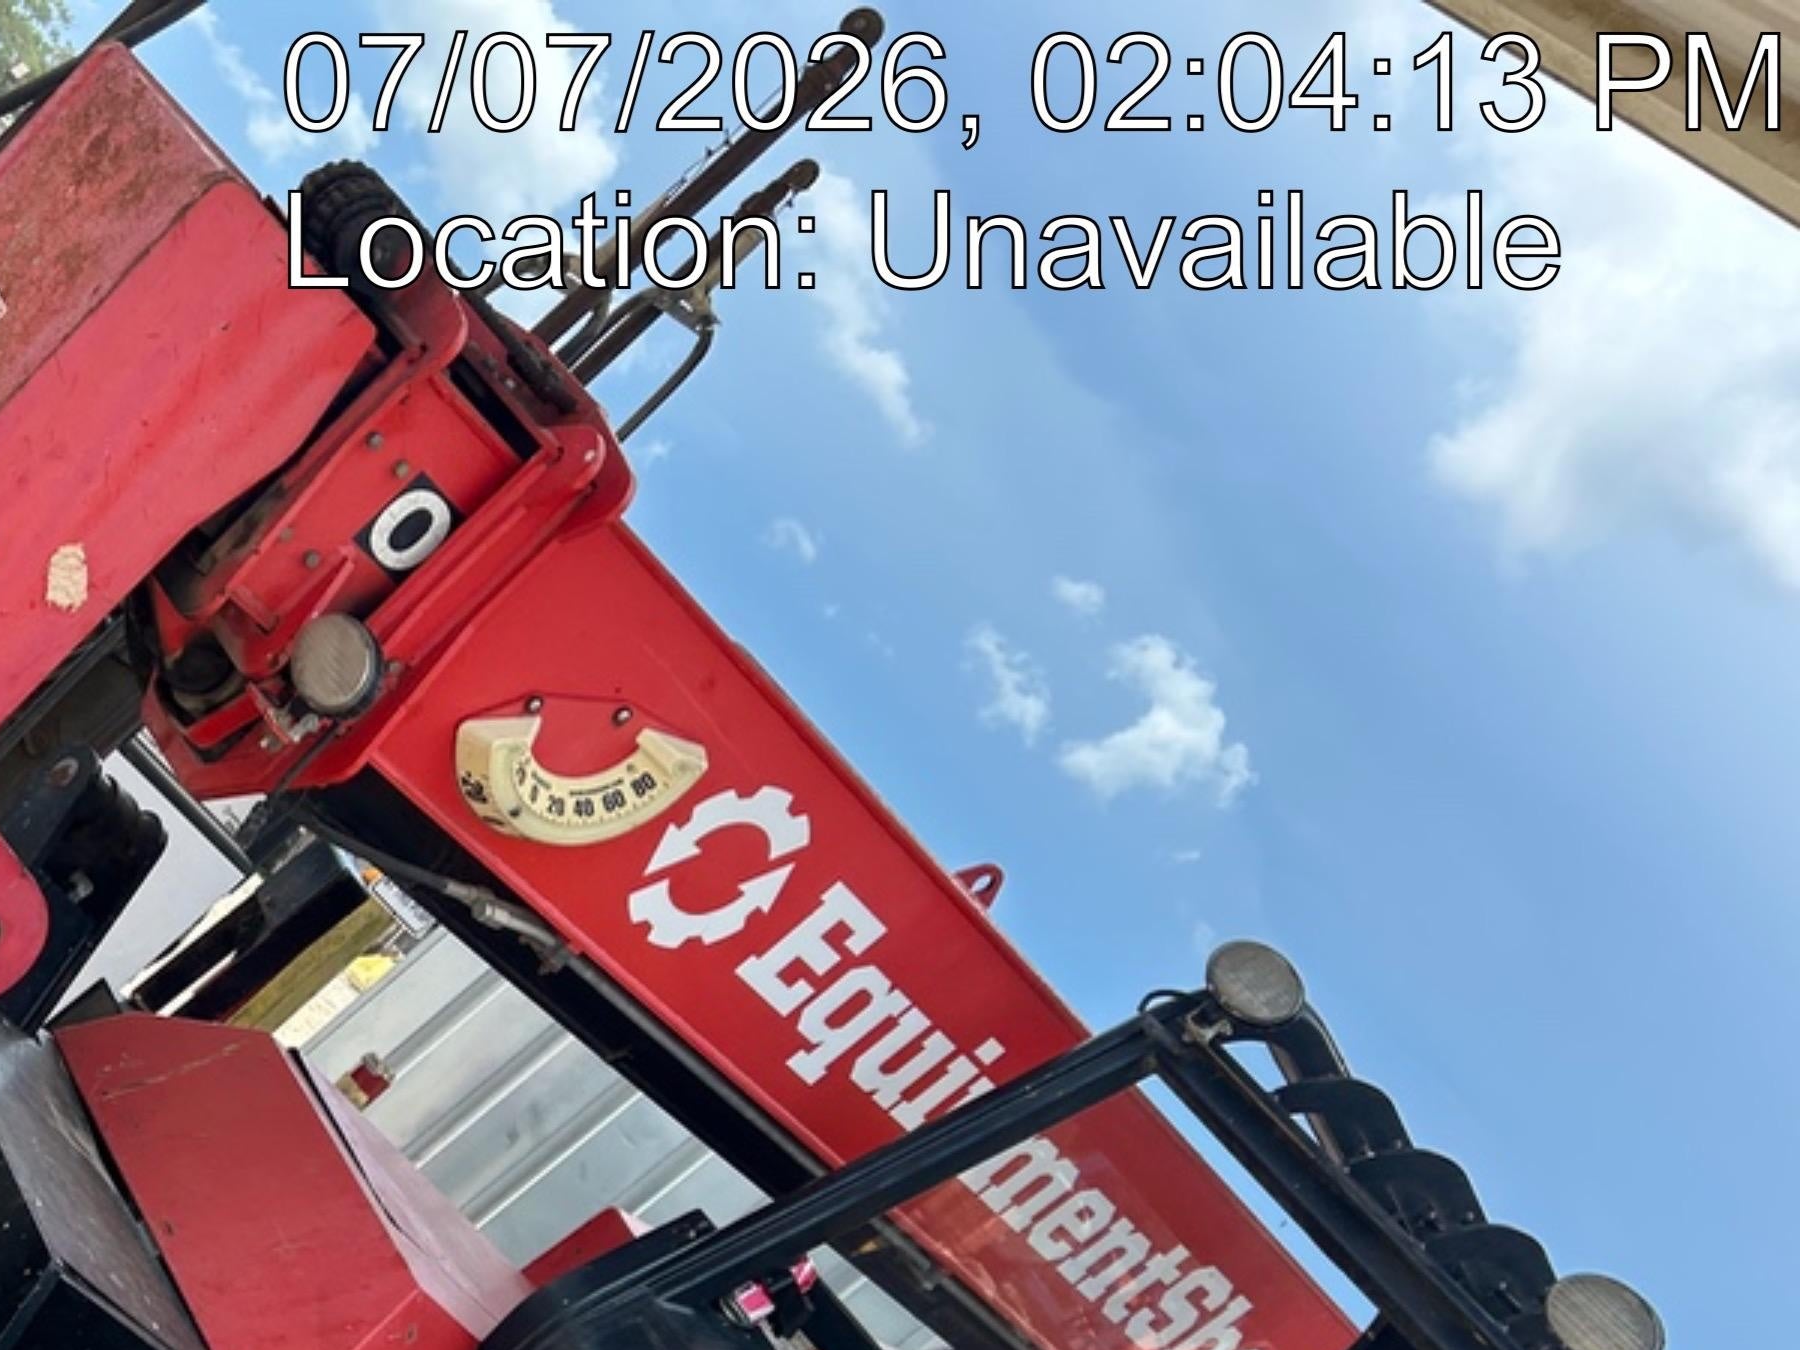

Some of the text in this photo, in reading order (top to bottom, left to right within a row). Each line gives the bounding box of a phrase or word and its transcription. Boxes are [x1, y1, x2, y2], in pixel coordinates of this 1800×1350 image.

[547, 795, 566, 817] 20
[573, 797, 595, 818] 40
[602, 789, 626, 812] 60
[630, 772, 657, 797] 80
